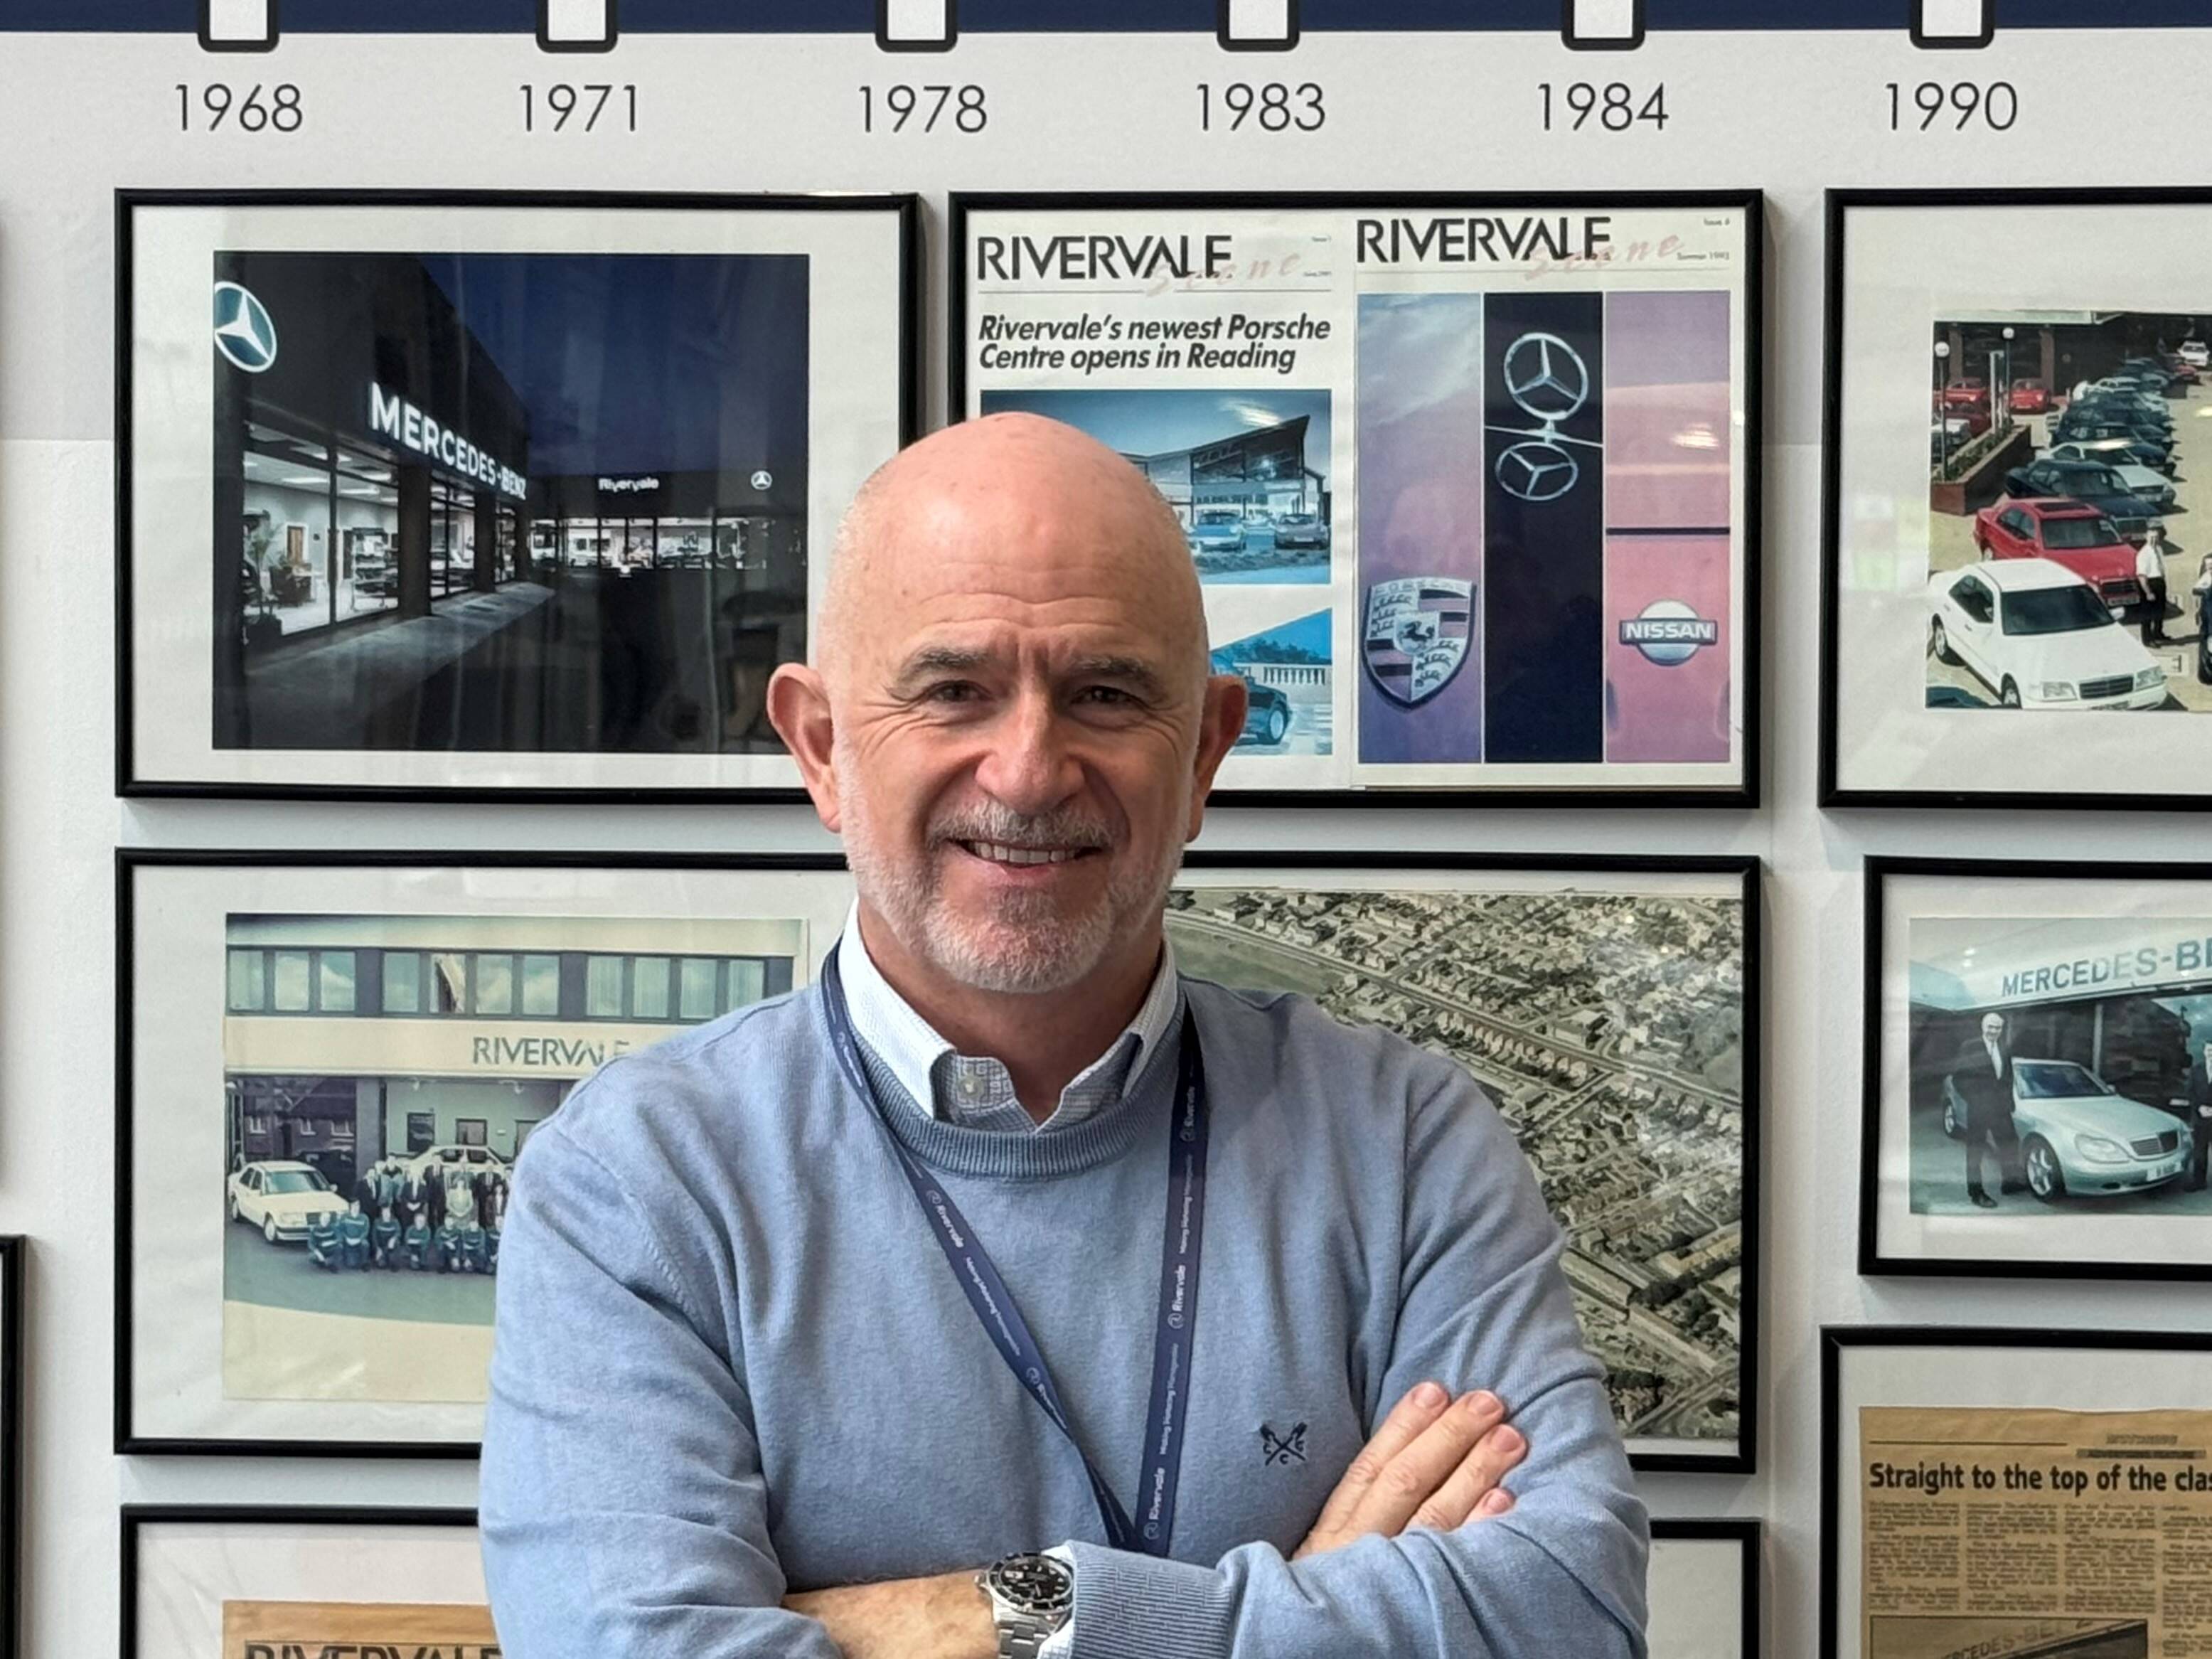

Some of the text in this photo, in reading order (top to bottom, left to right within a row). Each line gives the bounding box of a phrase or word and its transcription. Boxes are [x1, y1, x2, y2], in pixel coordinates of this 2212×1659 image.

[176, 84, 303, 133] 1968
[521, 85, 636, 132] 1971
[860, 85, 988, 134] 1978
[1198, 83, 1326, 132] 1983
[1539, 83, 1669, 132] 1984
[1887, 82, 2018, 132] 1990
[978, 235, 1232, 280] RIVERVALE
[1357, 216, 1612, 263] RIVERVALE
[1128, 317, 1224, 341] newest
[1227, 313, 1331, 341] Porsche
[979, 341, 1297, 375] Centre opens in Reading
[370, 381, 527, 501] MERCEDES-BENZ
[599, 476, 660, 493] Rivervale
[1626, 622, 1711, 639] NISSAN
[1869, 1461, 1965, 1496] Straight
[1972, 1465, 1997, 1490] to
[2004, 1463, 2043, 1490] the
[2050, 1465, 2089, 1498] top
[2097, 1463, 2122, 1491] of
[2128, 1464, 2167, 1492] the
